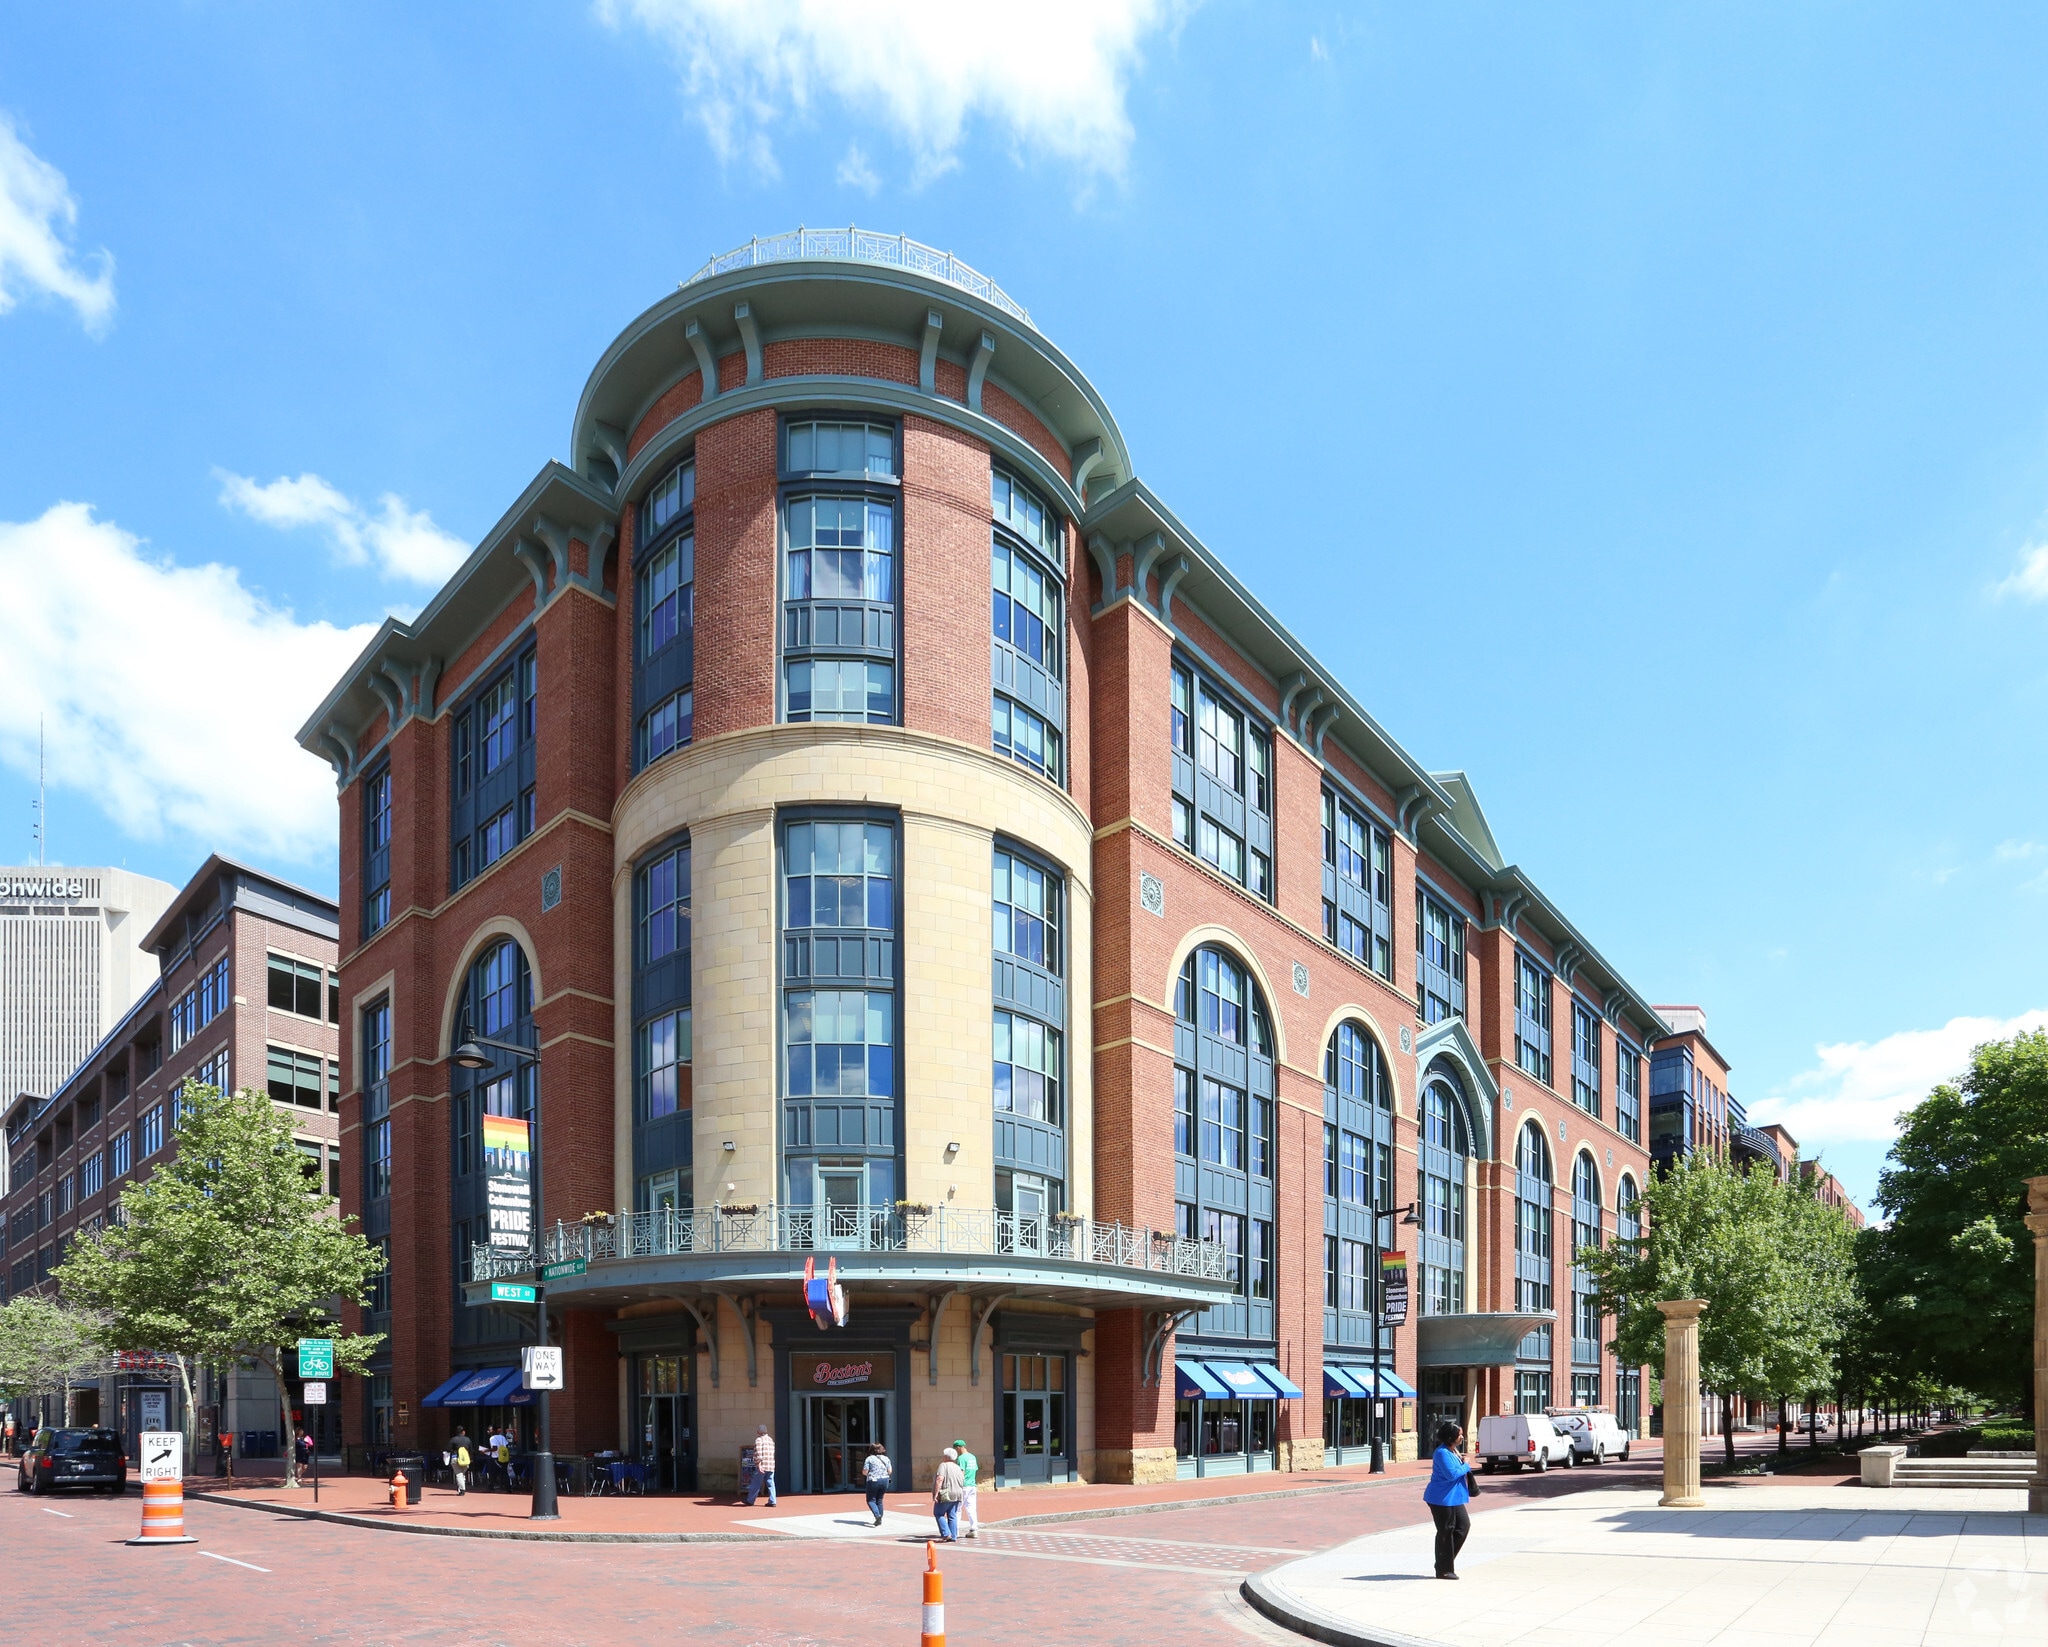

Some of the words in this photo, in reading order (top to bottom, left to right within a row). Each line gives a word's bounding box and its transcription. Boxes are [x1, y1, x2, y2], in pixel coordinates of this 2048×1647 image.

[488, 1180, 530, 1195] Stonewall
[489, 1193, 531, 1208] Columbus
[490, 1209, 530, 1231] PRIDE
[490, 1232, 529, 1247] FESTIVAL
[548, 1262, 576, 1277] NATIONWIDE
[496, 1286, 521, 1298] WEST
[1385, 1286, 1408, 1294] Stonewall
[1385, 1293, 1408, 1301] Columbus
[1386, 1301, 1407, 1313] PRIDE
[1385, 1313, 1405, 1321] FESTIVAL
[535, 1350, 556, 1360] ONE
[535, 1362, 556, 1371] WAY
[813, 1361, 873, 1383] Boston's
[148, 1437, 176, 1447] KEEP
[146, 1467, 177, 1476] RIGHT
